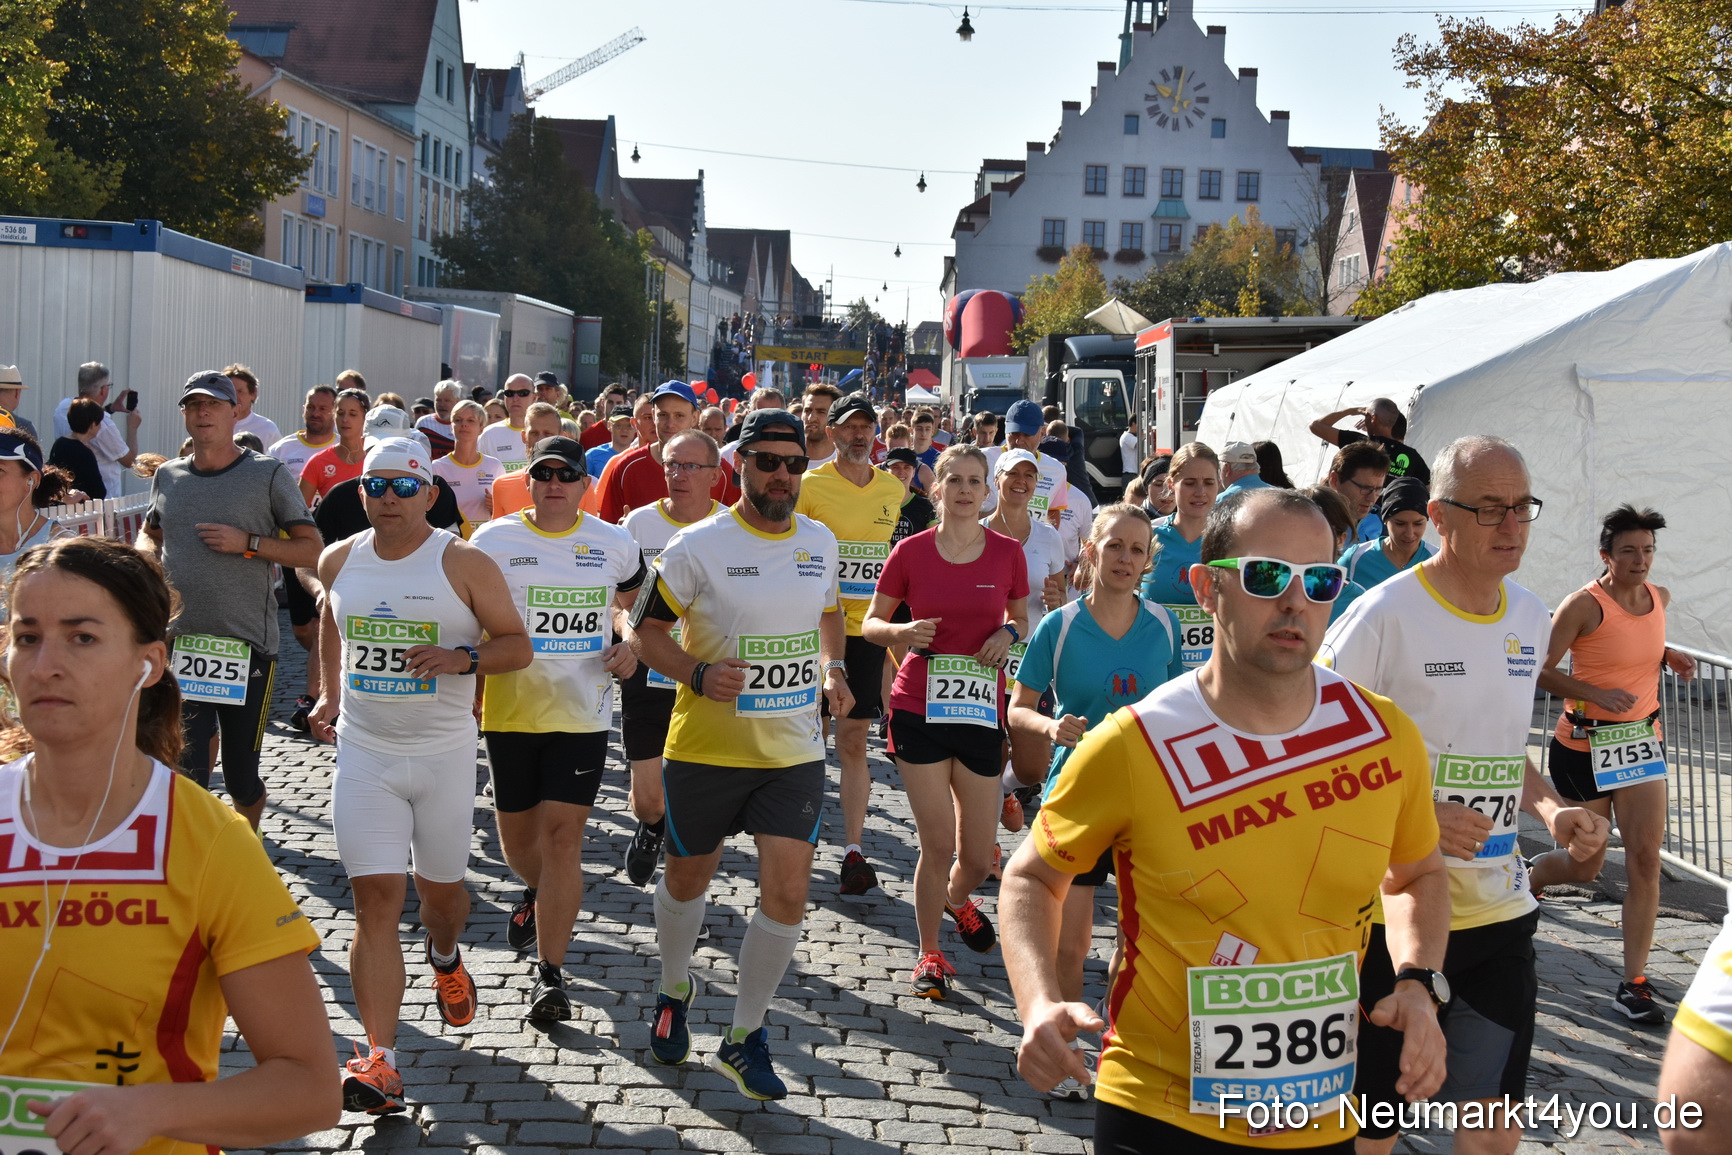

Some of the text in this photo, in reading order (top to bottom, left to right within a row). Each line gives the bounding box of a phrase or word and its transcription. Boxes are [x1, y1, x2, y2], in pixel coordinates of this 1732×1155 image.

[18, 226, 27, 235] 80
[791, 351, 829, 361] START
[574, 545, 589, 555] 20
[795, 552, 810, 562] 20
[838, 543, 887, 557] BOCK
[838, 561, 884, 579] 2768
[535, 590, 601, 605] BOCK
[354, 620, 431, 640] BOCK
[535, 611, 599, 634] 2048
[181, 636, 242, 655] BOCK
[541, 639, 591, 651] JÜRGEN
[746, 635, 814, 656] BOCK
[1506, 639, 1520, 654] 20
[179, 656, 239, 680] 2025
[355, 645, 407, 673] 235
[1425, 662, 1465, 673] BOCK
[749, 660, 814, 689] 2026
[182, 682, 230, 696] JÜRGEN
[363, 679, 416, 692] STEFAN
[936, 679, 992, 704] 2244
[754, 693, 808, 709] MARKUS
[943, 706, 986, 719] TERESA
[1597, 725, 1647, 743] BOCK
[1600, 742, 1653, 768] 2153
[1447, 761, 1522, 783] BOCK
[1616, 767, 1646, 781] ELKE
[1187, 756, 1402, 850] MAX BÖGL
[57, 891, 169, 927] BÖGL
[1206, 965, 1345, 1005] BOCK
[1214, 1013, 1347, 1069] 2386
[1210, 1072, 1345, 1101] SEBASTIAN
